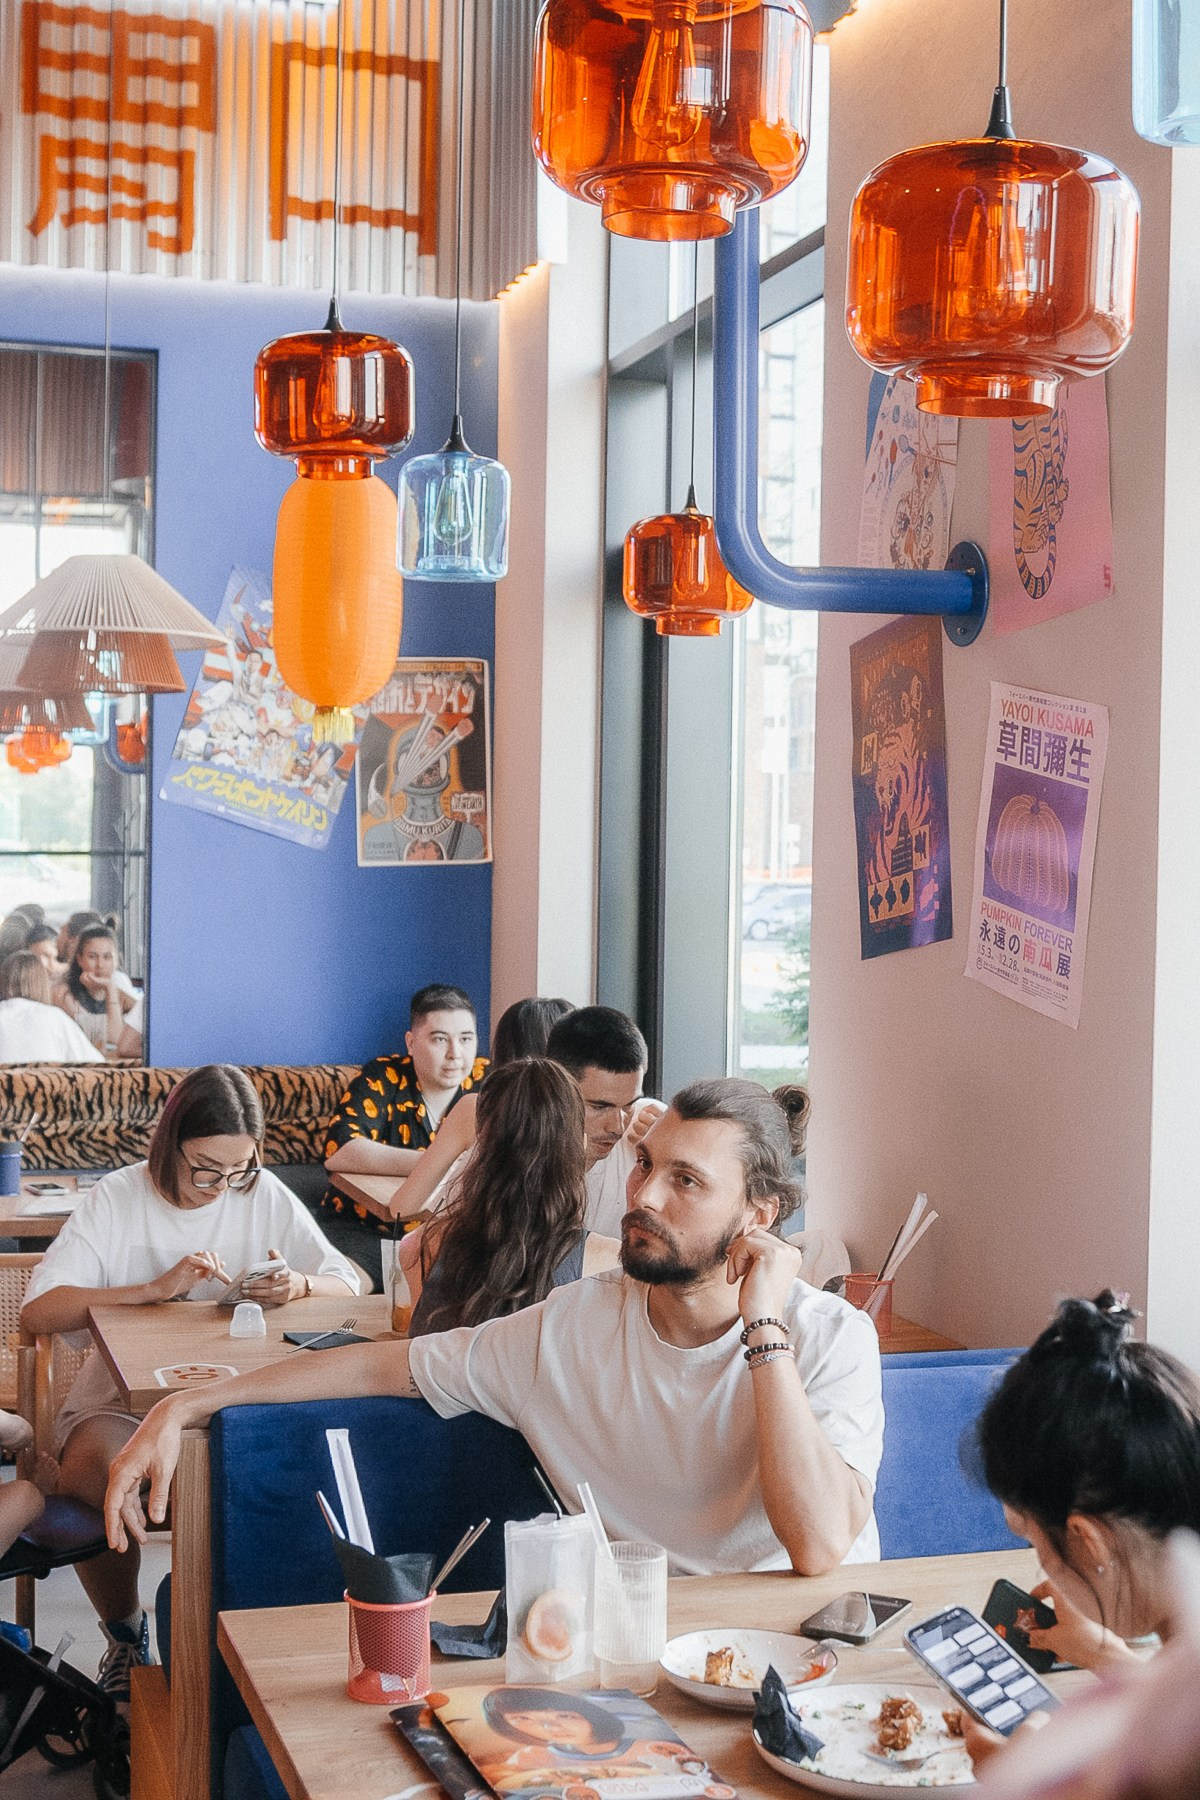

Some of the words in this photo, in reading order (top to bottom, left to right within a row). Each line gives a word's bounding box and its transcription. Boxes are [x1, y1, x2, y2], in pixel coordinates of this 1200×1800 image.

[1001, 698, 1034, 724] YAYOI
[1037, 707, 1095, 739] KUSAMA
[996, 719, 1092, 784] 草間彌生
[979, 918, 1071, 980] 永遠の南瓜展
[980, 901, 1022, 932] PUMPKIN
[1023, 920, 1073, 953] FOREVER
